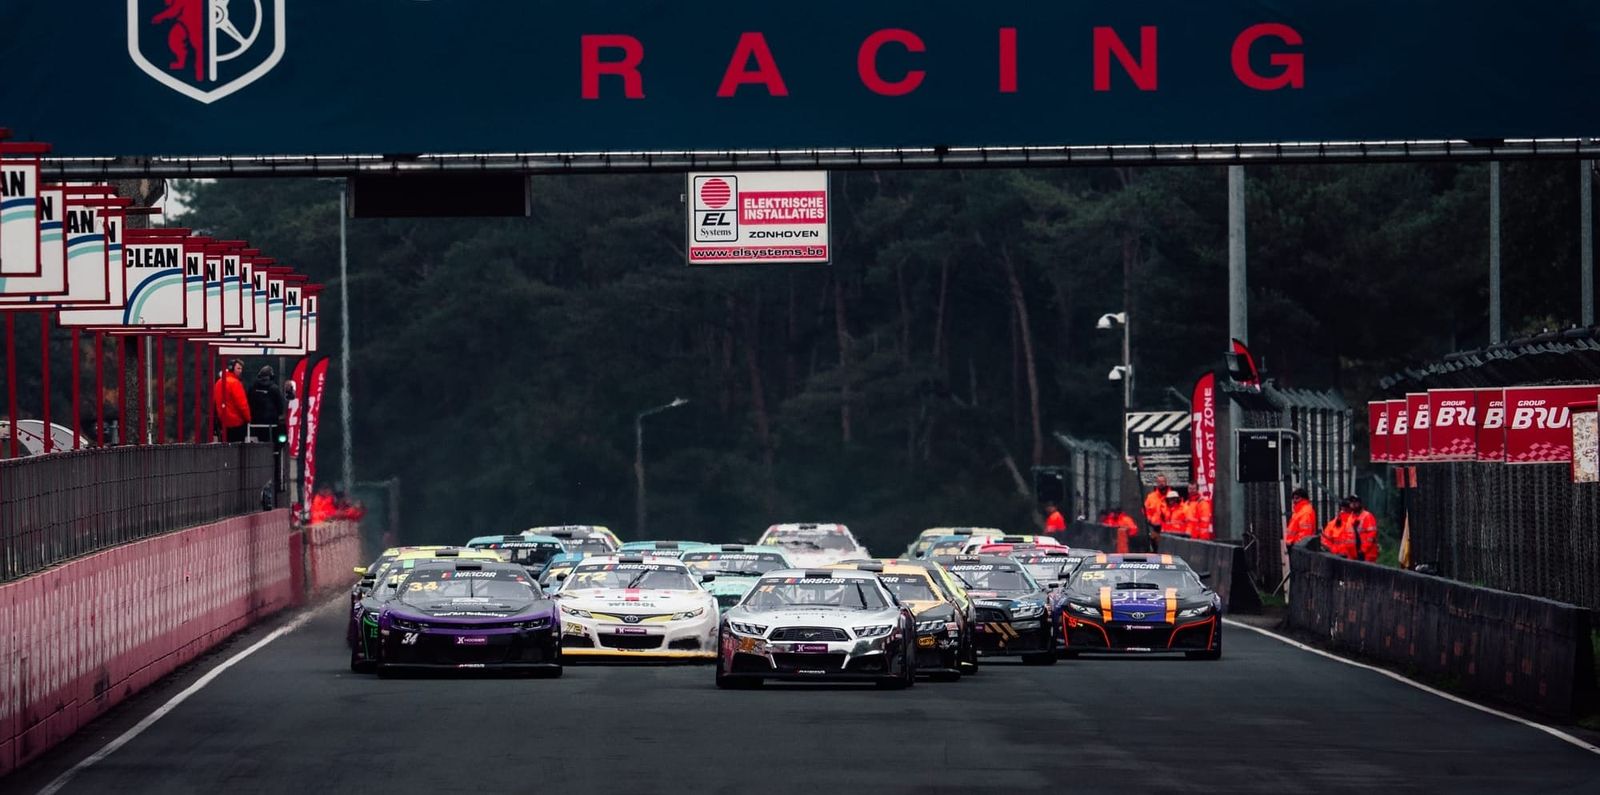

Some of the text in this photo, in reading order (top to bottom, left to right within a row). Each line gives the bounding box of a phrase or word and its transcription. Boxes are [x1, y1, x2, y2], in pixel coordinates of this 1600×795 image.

[581, 23, 1306, 99] RACING
[744, 197, 824, 209] ELEKTRISCHE
[702, 213, 730, 226] EL
[744, 208, 825, 220] INSTALLATIES
[701, 228, 732, 238] Systems
[749, 230, 819, 238] ZONHOVEN
[126, 248, 178, 267] CLEAN
[694, 248, 823, 258] www.elsystems.be
[1204, 388, 1214, 426] ZONE
[1512, 407, 1572, 429] BRU
[1206, 432, 1215, 478] START
[409, 581, 438, 592] 34
[402, 632, 419, 645] 34
